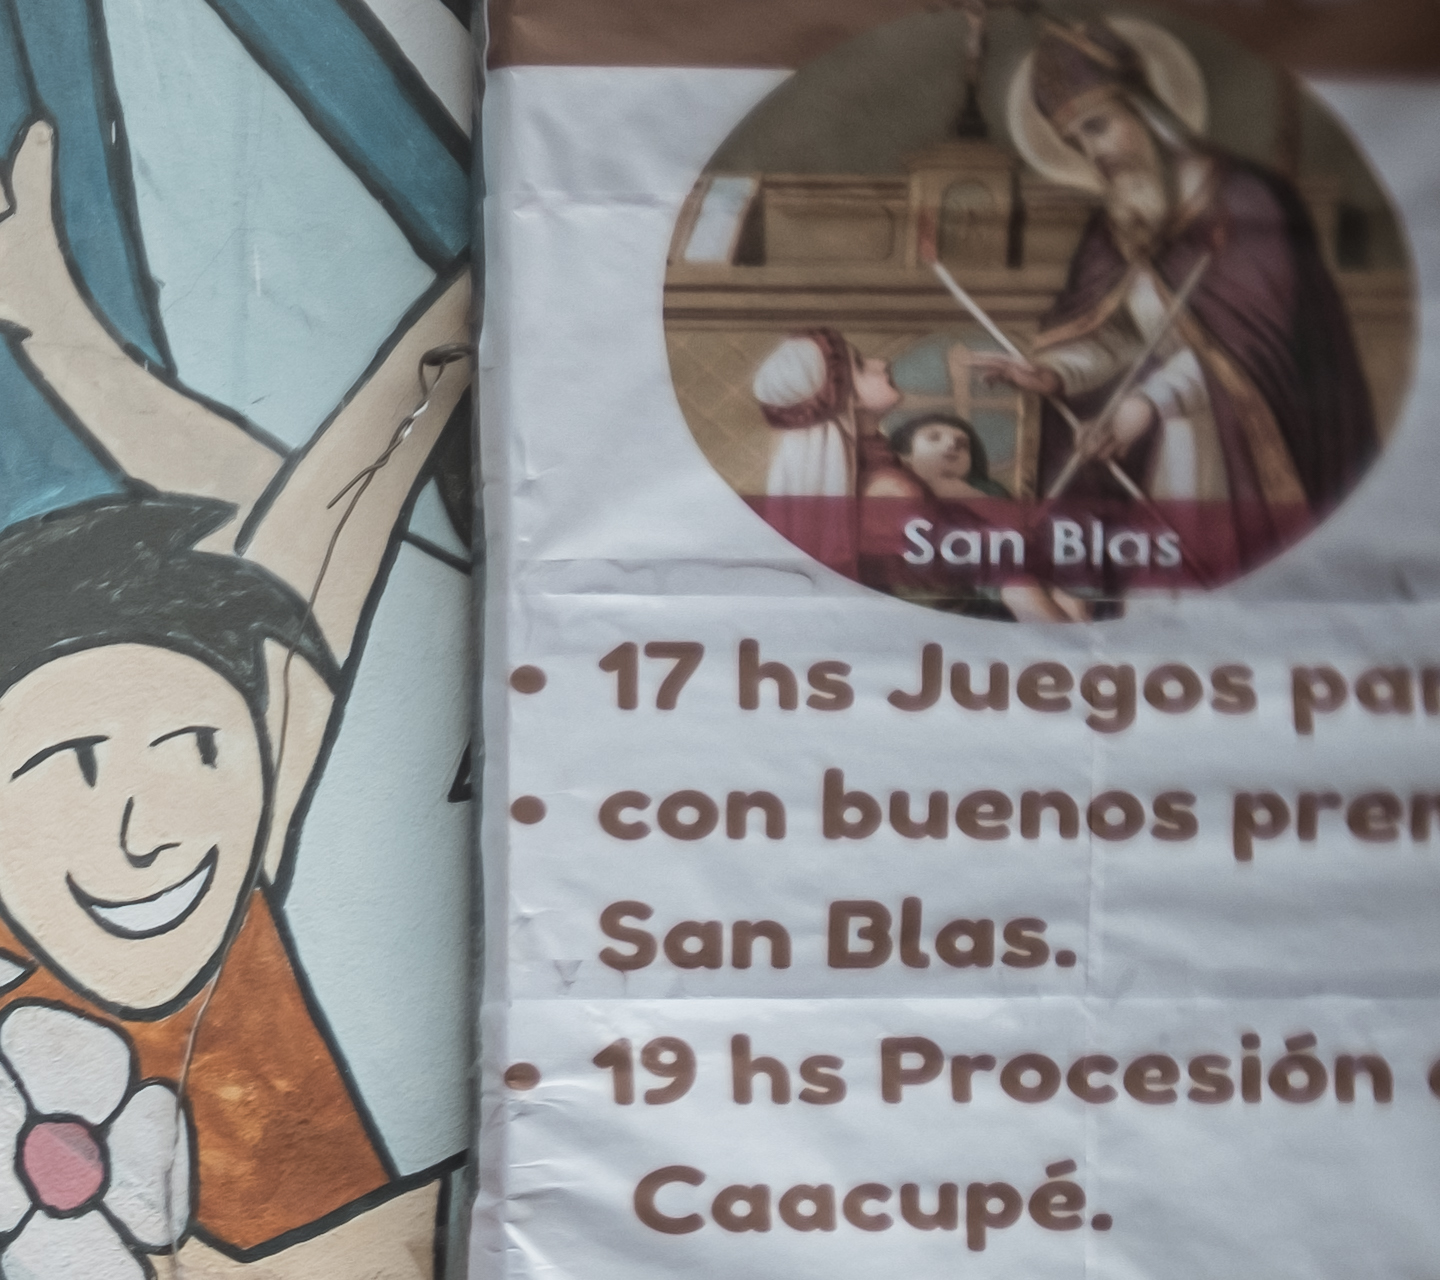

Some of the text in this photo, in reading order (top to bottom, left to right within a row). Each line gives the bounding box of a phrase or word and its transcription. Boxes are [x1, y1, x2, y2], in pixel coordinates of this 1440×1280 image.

[902, 517, 1182, 569] San Blas
[598, 639, 707, 712] 17
[737, 637, 856, 712] hs
[887, 639, 1259, 734] Juegos
[598, 785, 788, 844] con
[821, 766, 1201, 844] buenos
[598, 895, 1081, 973] San Blas.
[590, 1034, 698, 1106] 19
[729, 1033, 848, 1106] hs
[879, 1030, 1396, 1106] Procesión
[631, 1158, 1115, 1253] Caacupé.
